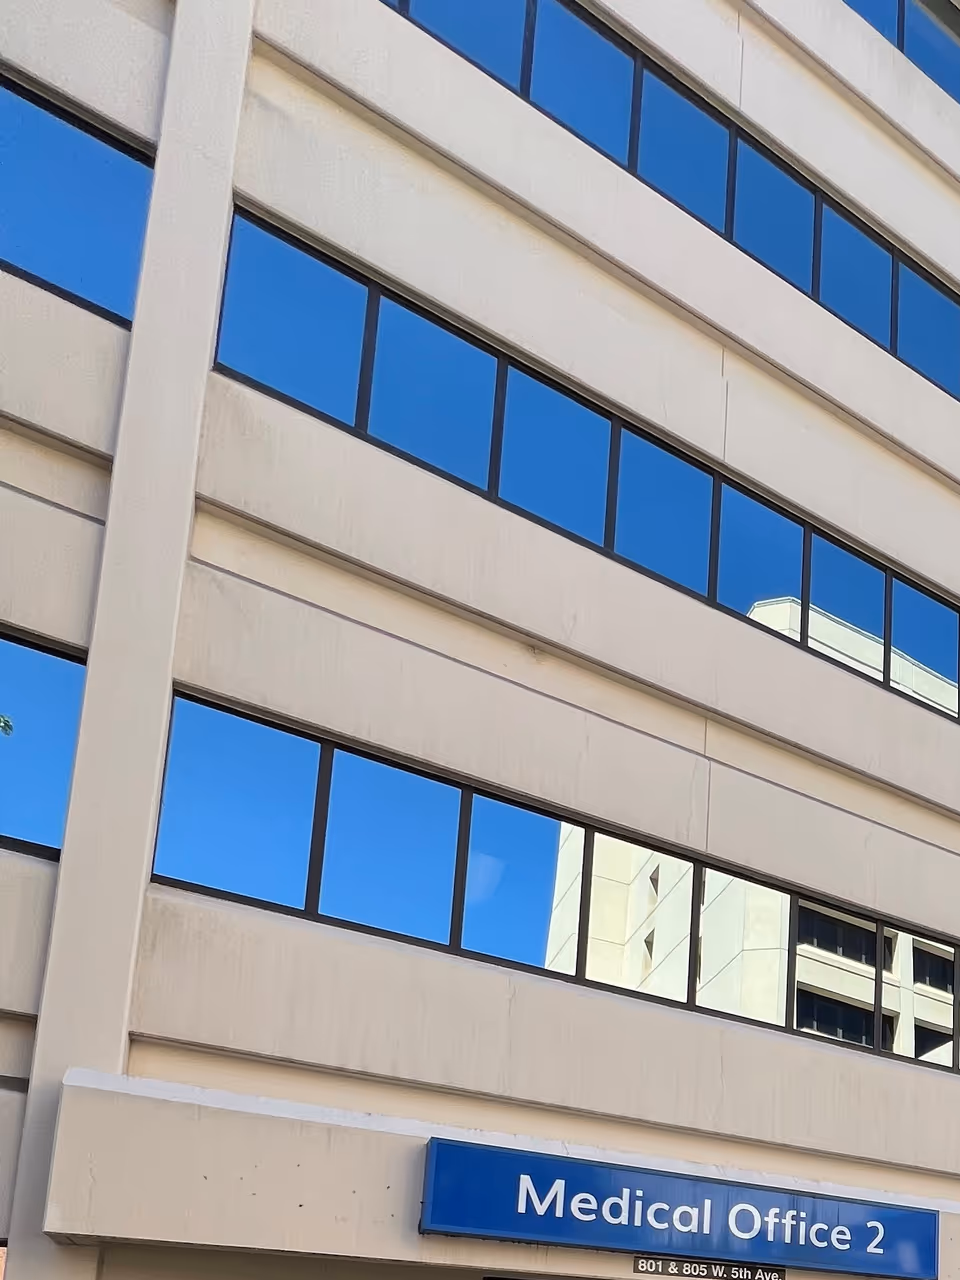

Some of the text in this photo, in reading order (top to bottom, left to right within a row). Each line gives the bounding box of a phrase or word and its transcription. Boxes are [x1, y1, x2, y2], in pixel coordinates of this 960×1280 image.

[517, 1173, 886, 1254] Medical Office 2
[638, 1259, 662, 1272] 801
[668, 1261, 678, 1274] &
[682, 1263, 707, 1276] 805
[711, 1265, 728, 1278] W.
[731, 1267, 751, 1280] 5th
